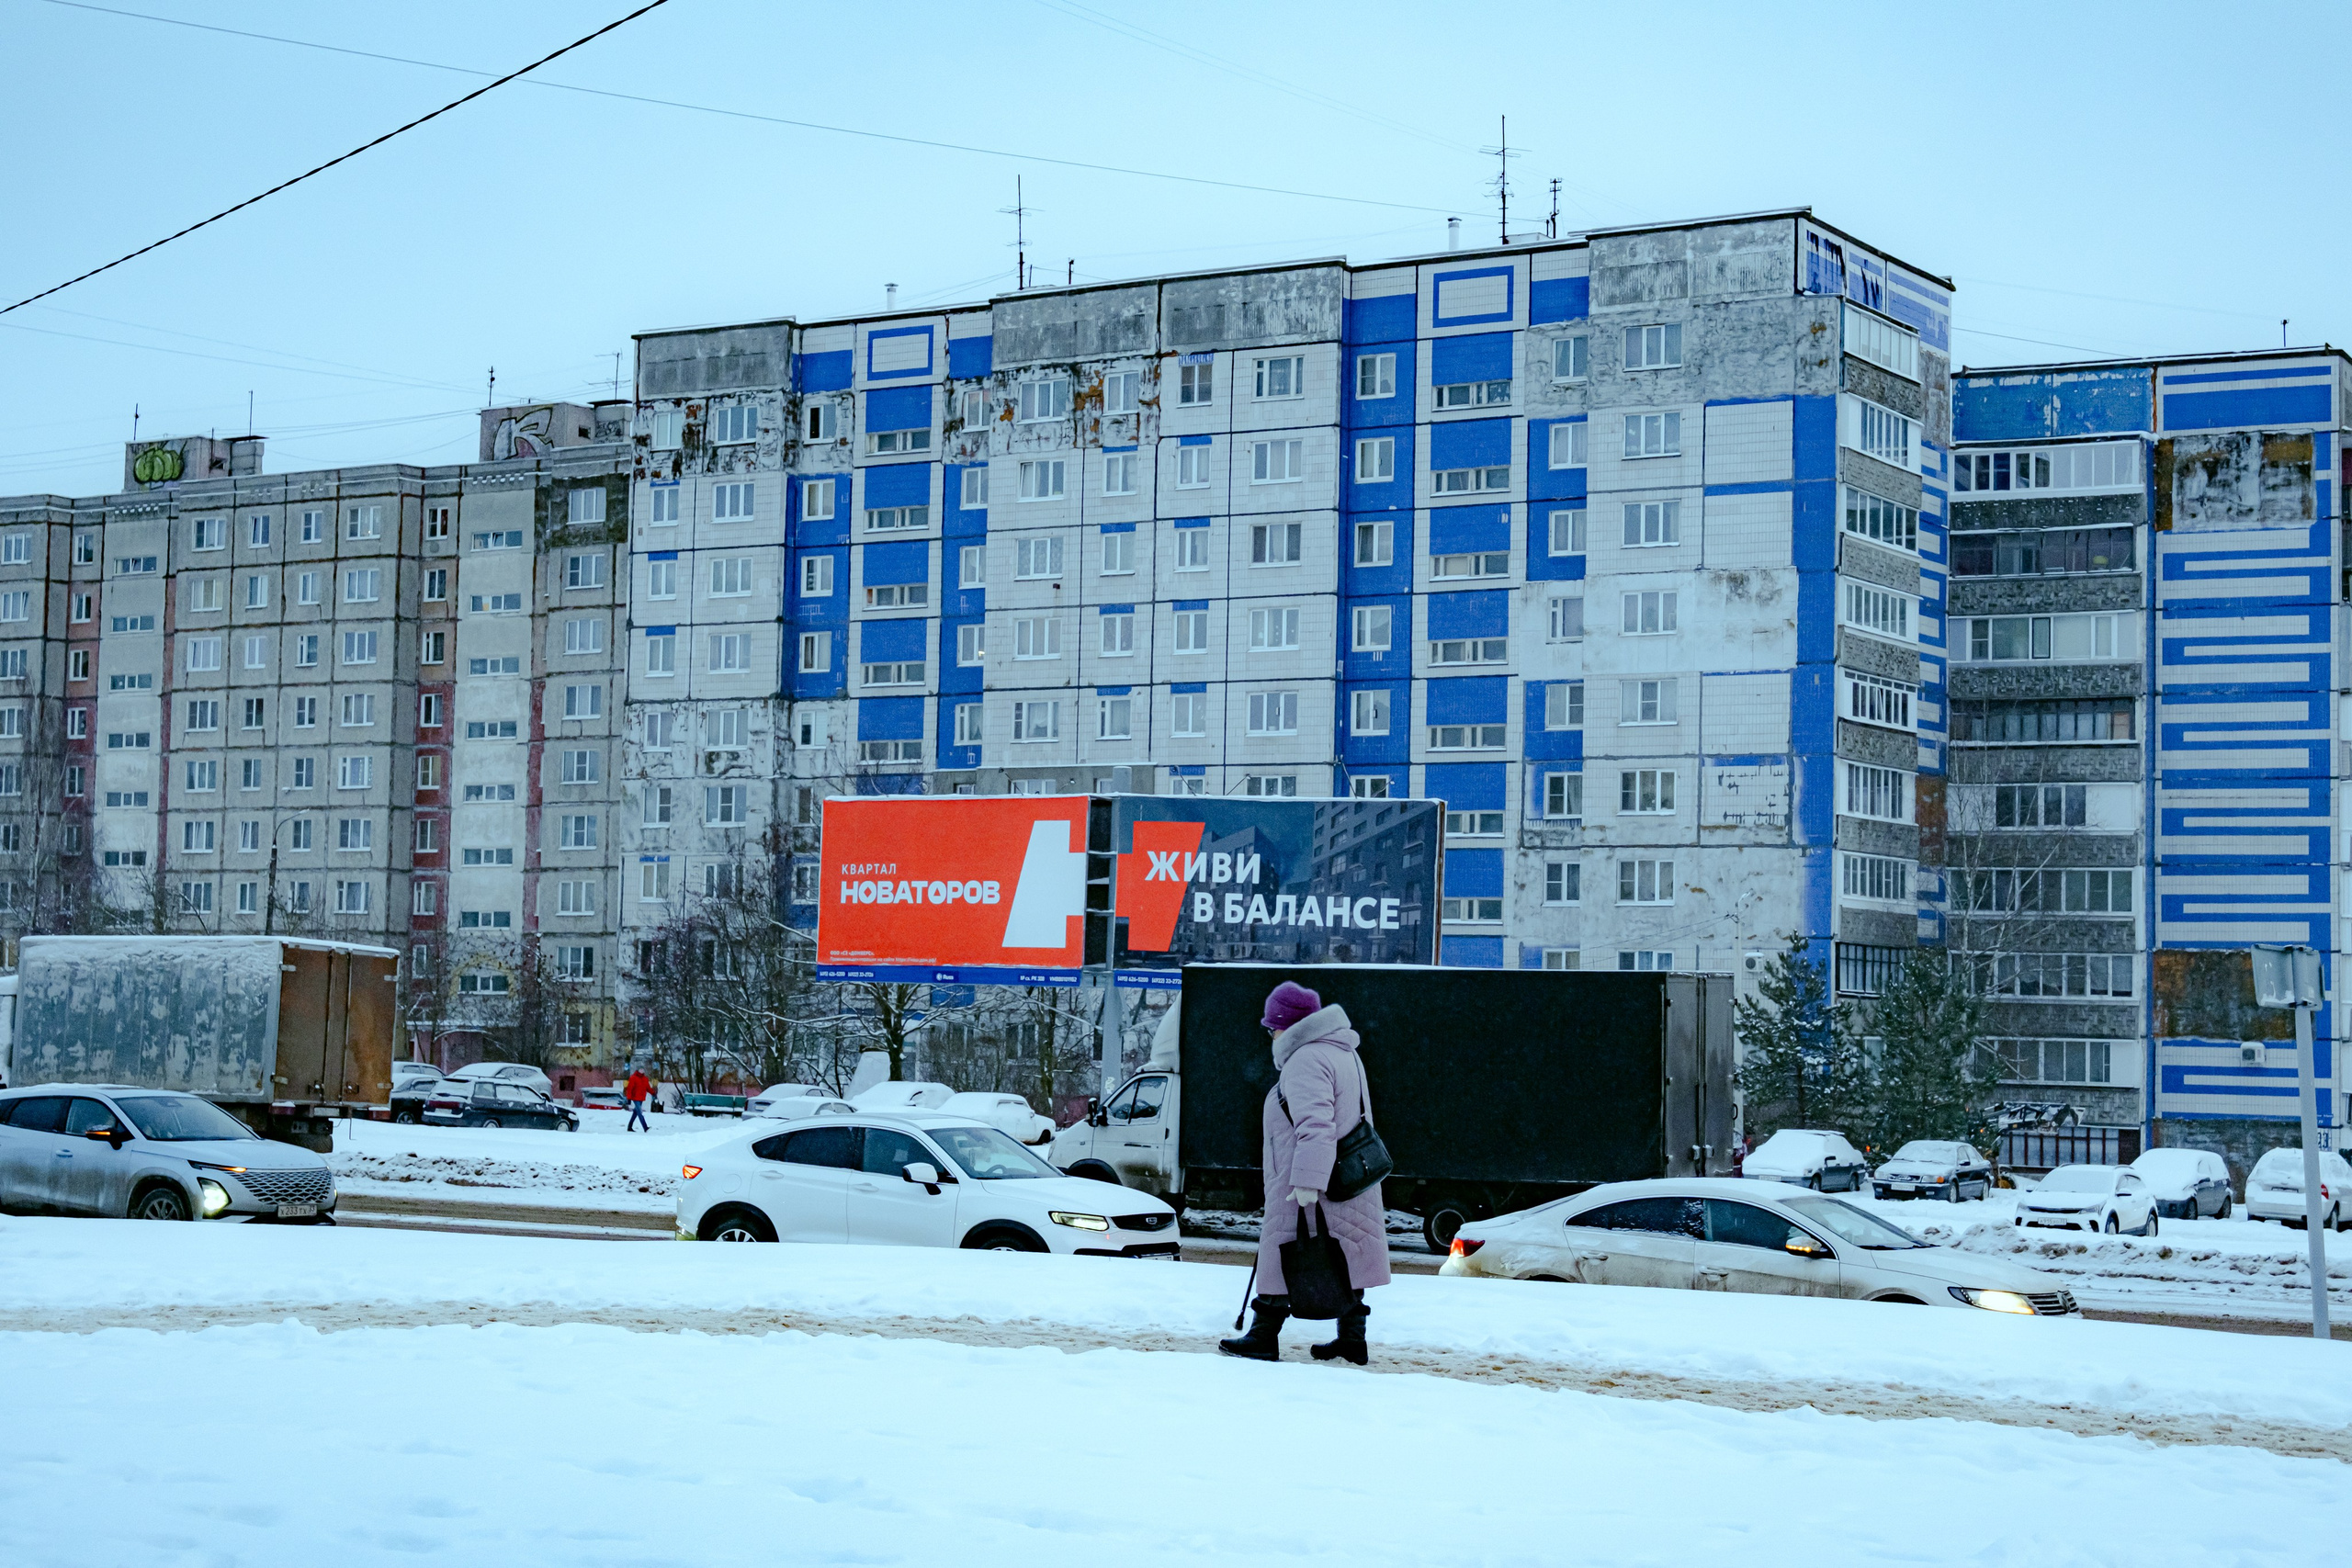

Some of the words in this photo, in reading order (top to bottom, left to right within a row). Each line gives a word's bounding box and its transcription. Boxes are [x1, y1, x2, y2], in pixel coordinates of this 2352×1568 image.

[842, 863, 897, 875] КВАРТАЛ
[1145, 851, 1261, 885] ЖИВИ
[841, 880, 1001, 905] НОВАТОРОВ
[1193, 892, 1214, 923] В
[1224, 893, 1401, 930] БАЛАНСЕ
